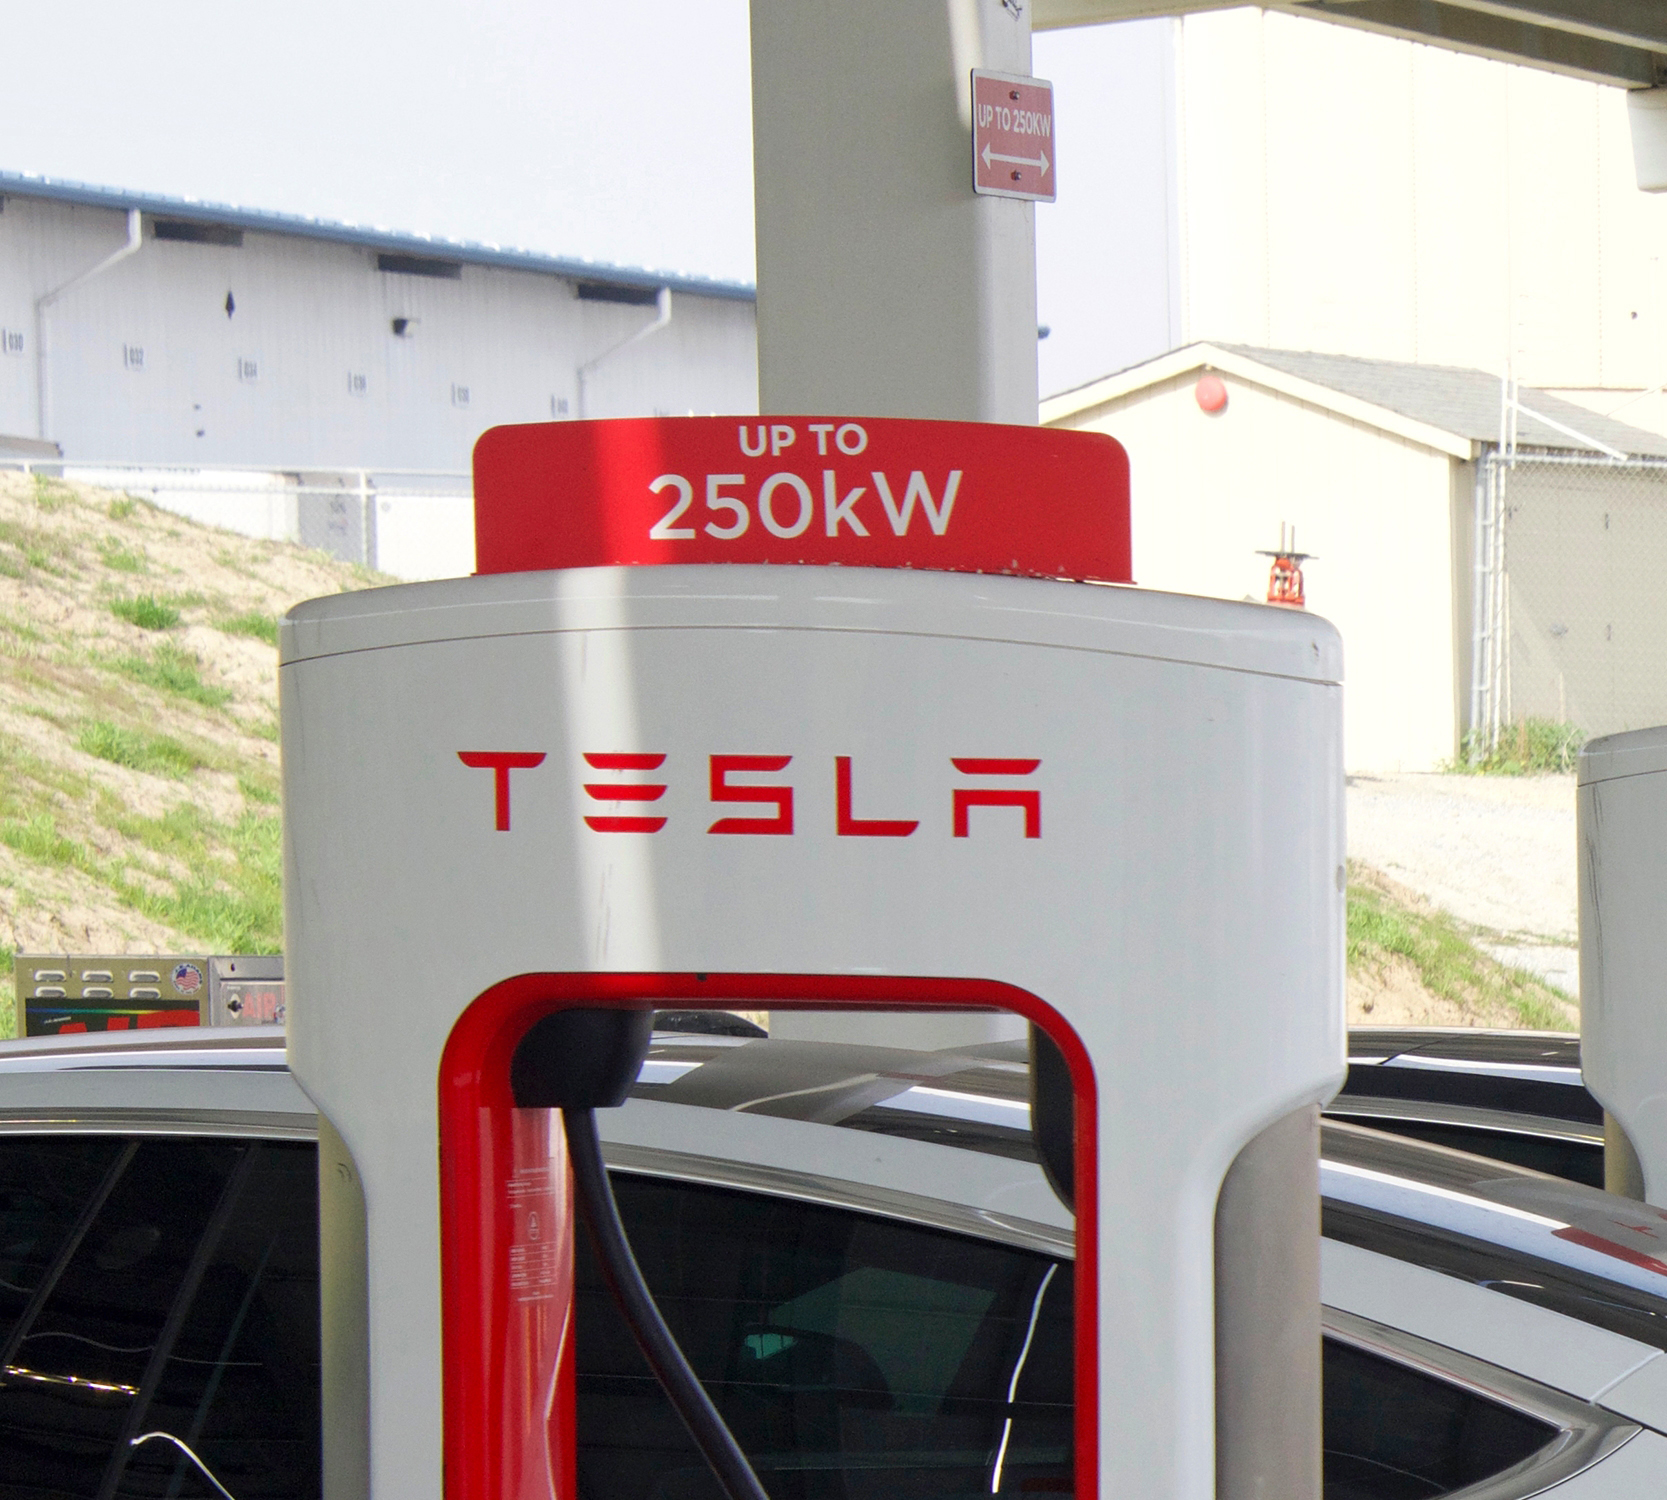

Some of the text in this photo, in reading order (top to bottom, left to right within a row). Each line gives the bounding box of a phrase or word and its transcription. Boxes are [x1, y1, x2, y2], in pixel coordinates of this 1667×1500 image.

[977, 103, 1052, 138] UP TO 250KW
[739, 423, 868, 457] UP TO
[648, 469, 963, 541] 250kW
[458, 751, 1042, 839] TESLA
